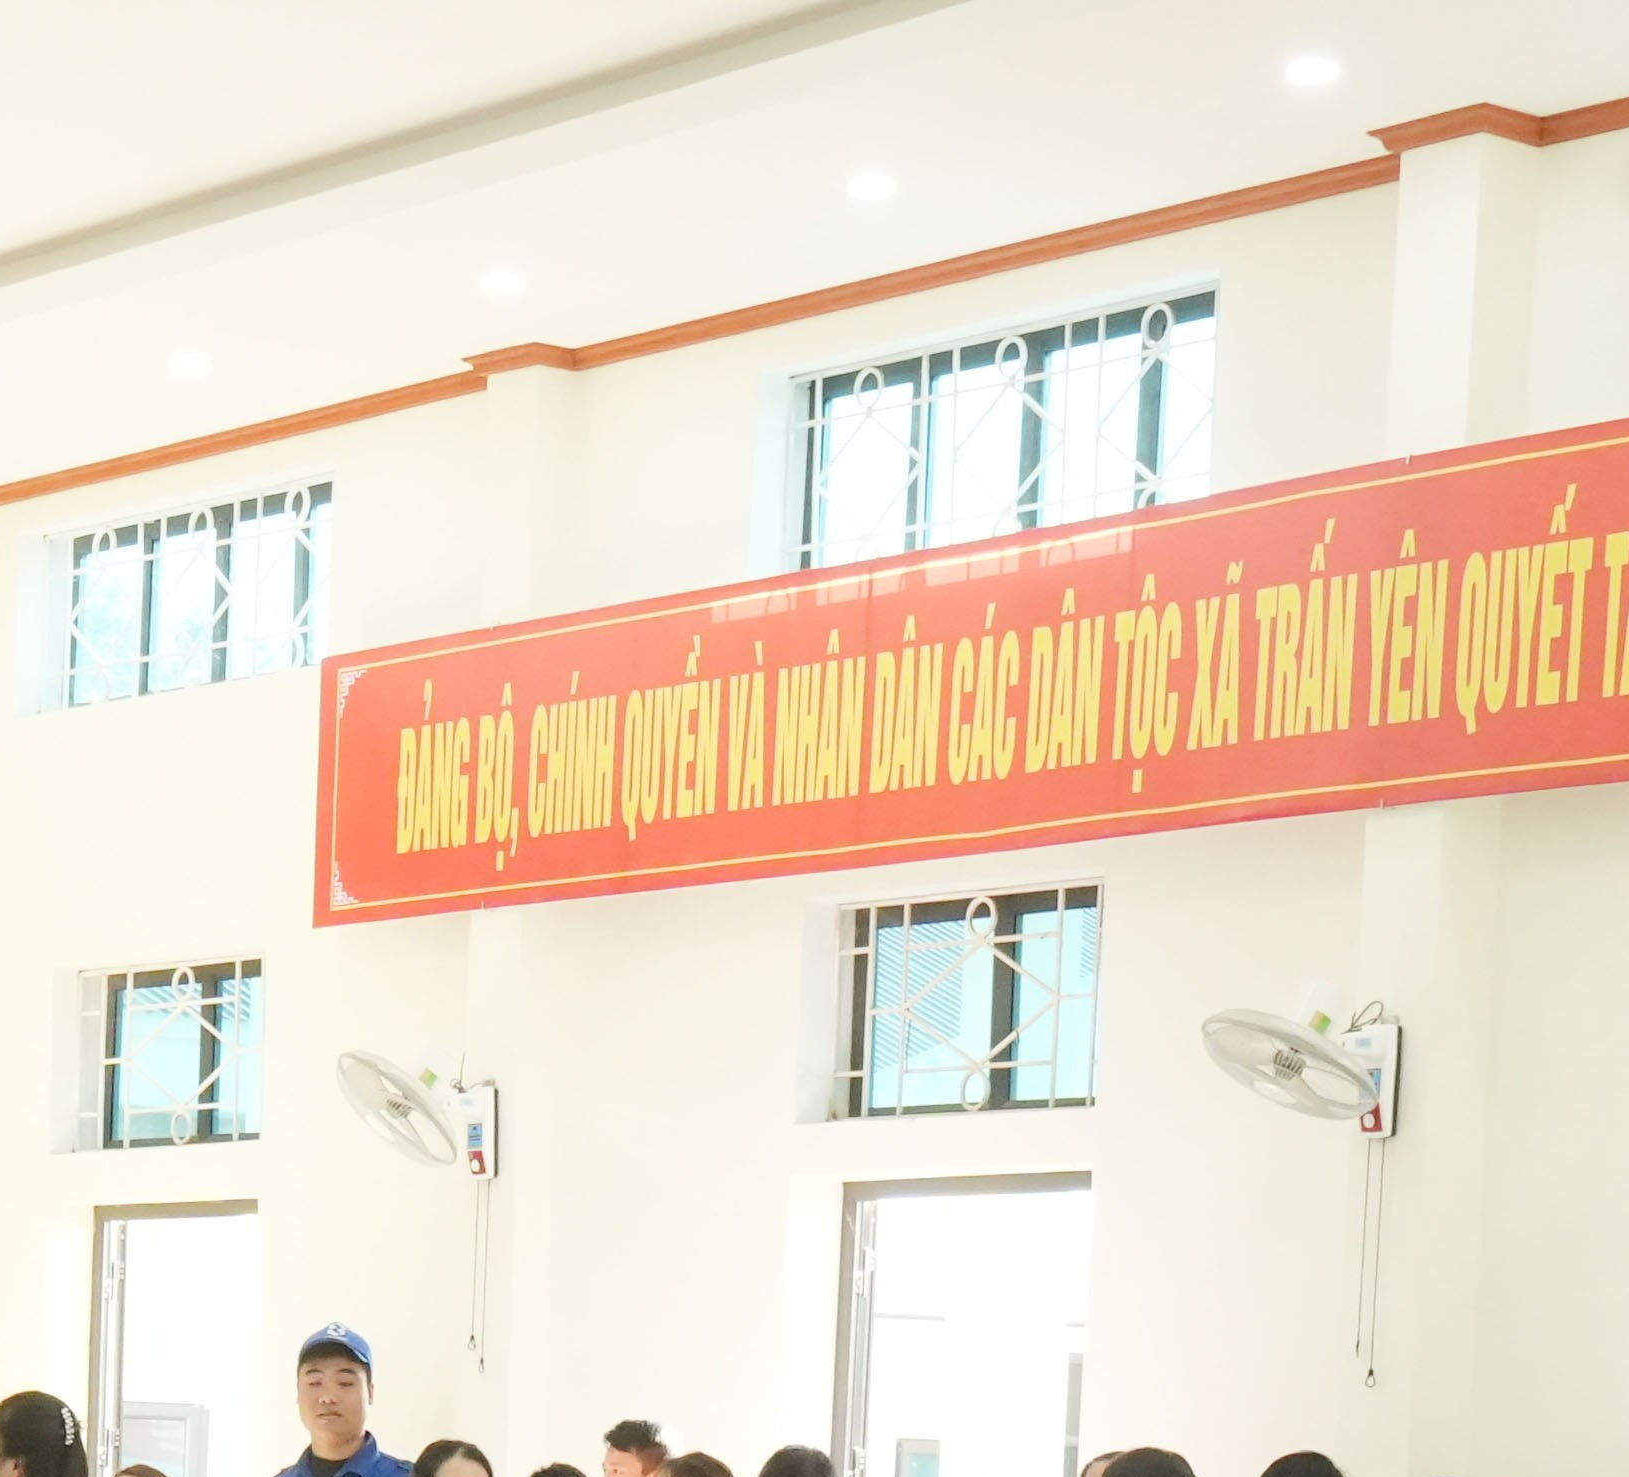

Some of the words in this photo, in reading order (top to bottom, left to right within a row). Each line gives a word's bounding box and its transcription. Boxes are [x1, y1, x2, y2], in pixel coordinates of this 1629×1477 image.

[396, 679, 472, 855] ĐẢNG
[474, 683, 519, 872] BỘ,
[527, 671, 619, 836] CHÍNH
[621, 637, 721, 841] QUYỀN
[727, 641, 768, 811] VÀ
[773, 630, 867, 807] NHÂN
[868, 616, 944, 792] DÂN
[946, 604, 1020, 783] CÁC
[1024, 589, 1106, 774] DÂN
[1111, 575, 1183, 793] TỘC
[1189, 562, 1242, 750] XÃ
[1254, 518, 1353, 741] TRẤN
[1368, 529, 1449, 725] YÊN
[1455, 482, 1595, 733] QUYẾT
